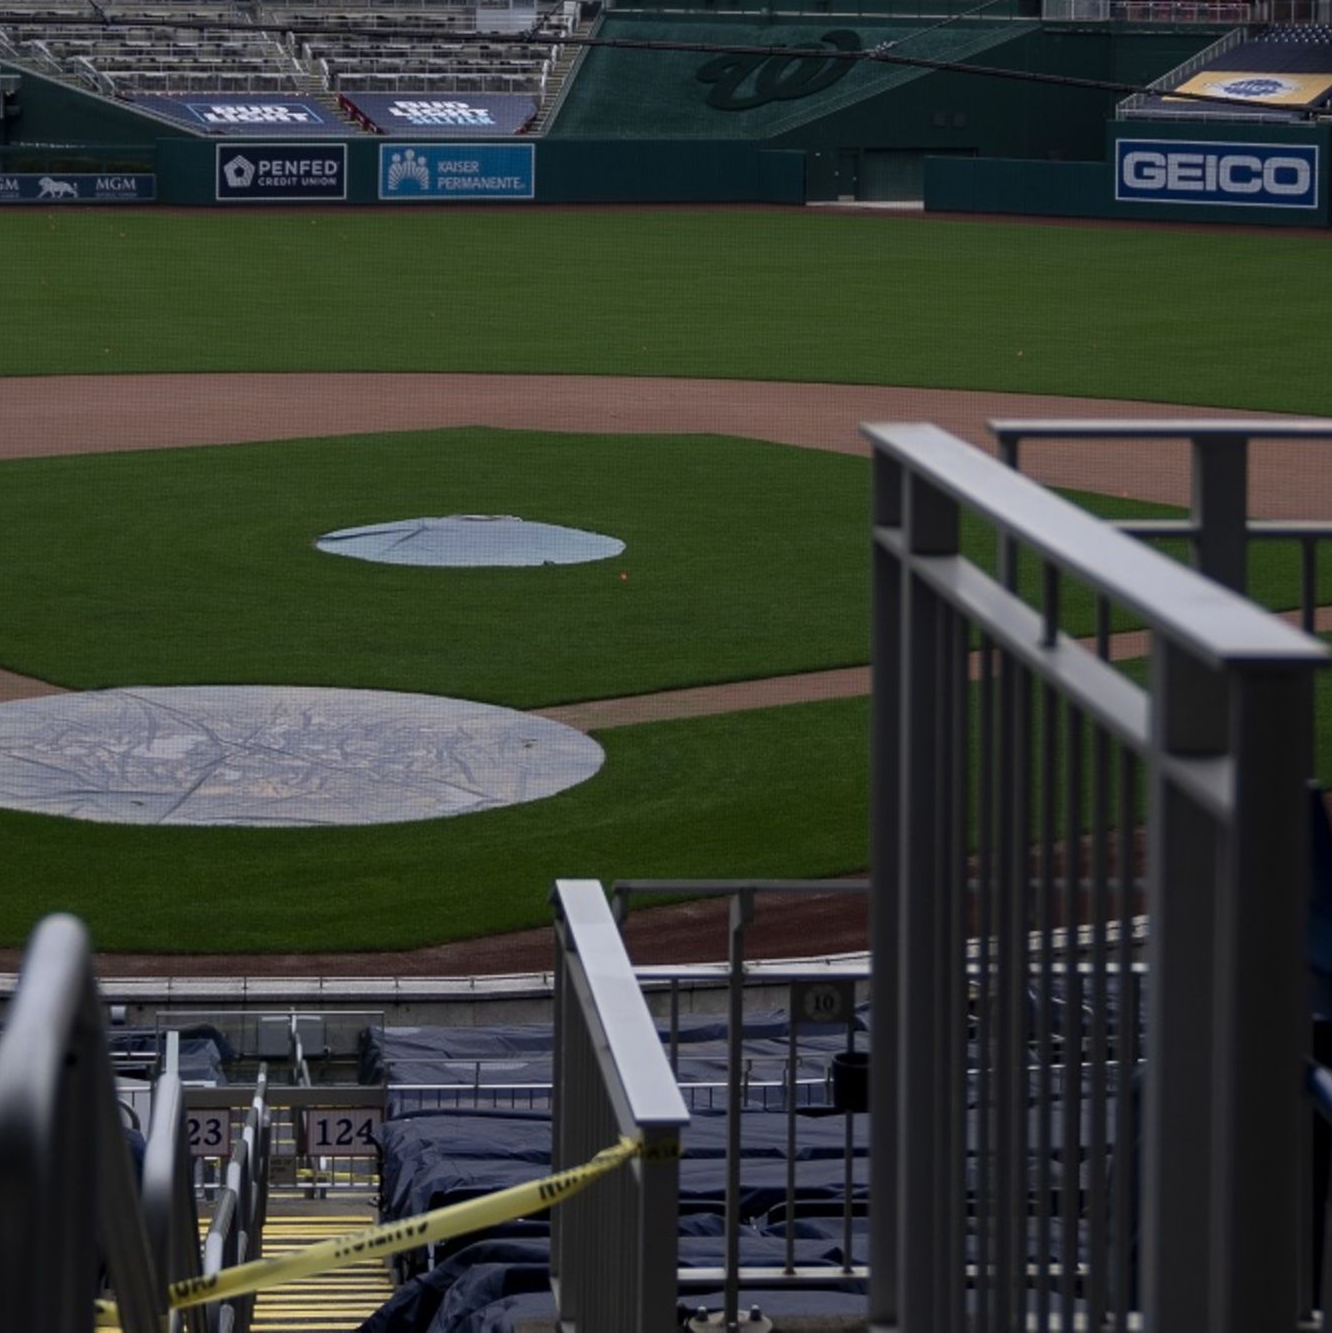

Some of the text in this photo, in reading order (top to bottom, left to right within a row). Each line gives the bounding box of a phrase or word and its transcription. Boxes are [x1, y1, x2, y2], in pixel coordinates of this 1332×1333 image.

[258, 160, 338, 176] PENFED
[437, 162, 480, 173] KAISER
[1122, 150, 1311, 196] GEICO
[95, 177, 137, 191] MGM
[258, 177, 338, 187] CREDIT UNION
[437, 176, 521, 190] PERMANENTE
[814, 994, 834, 1011] 10
[186, 1118, 375, 1146] 23 124
